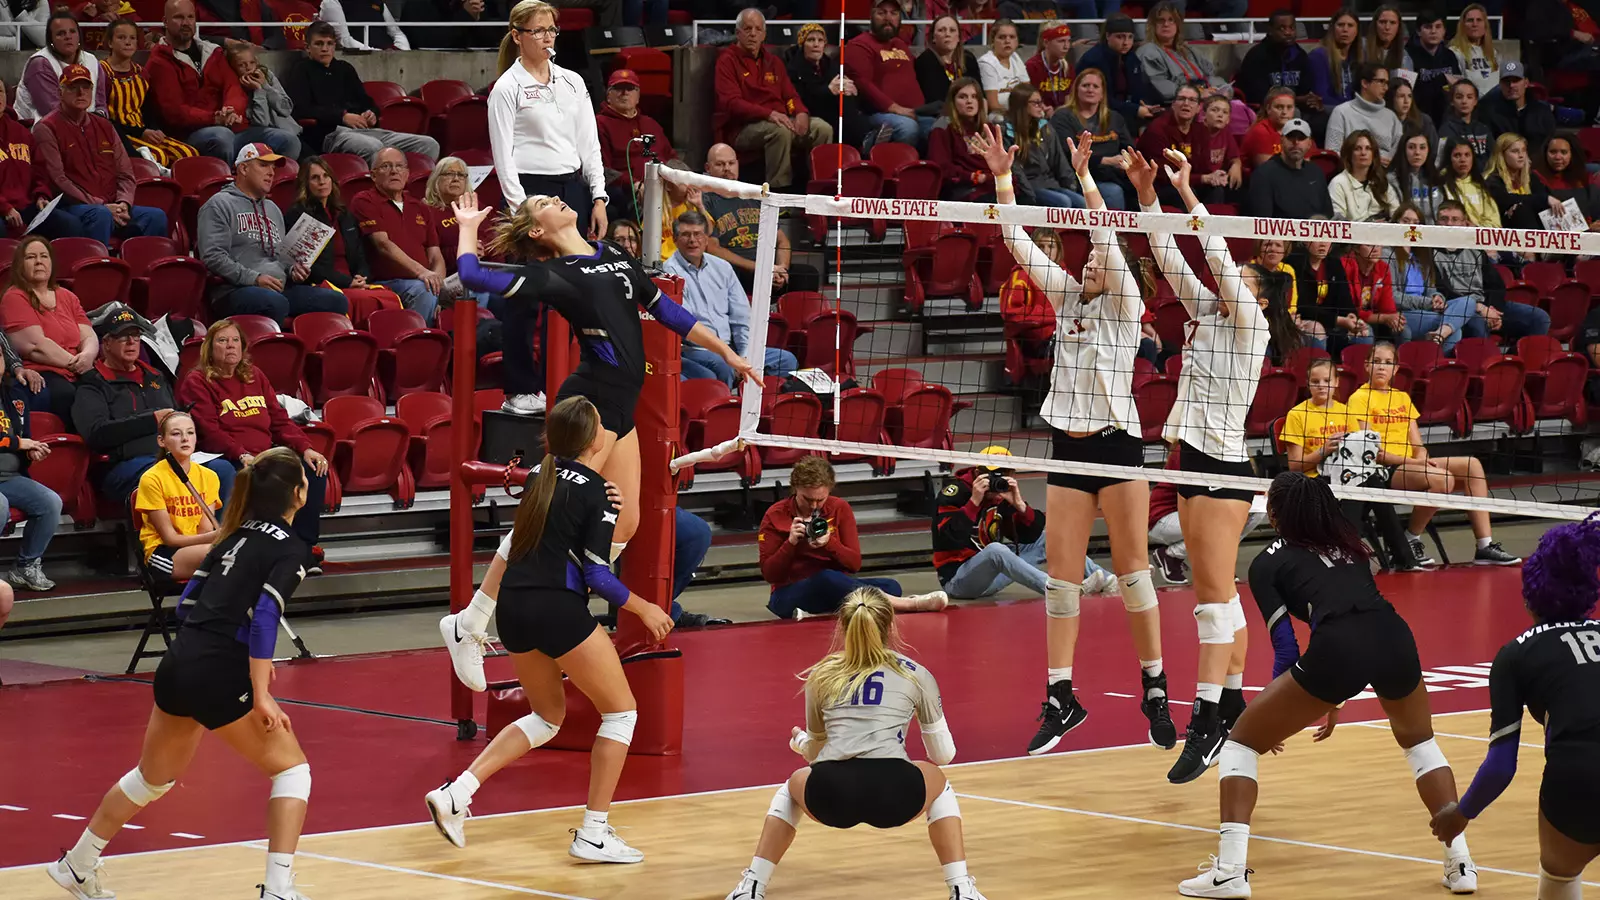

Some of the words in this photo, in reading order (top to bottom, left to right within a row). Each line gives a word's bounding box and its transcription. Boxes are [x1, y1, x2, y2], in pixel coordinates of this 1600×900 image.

[851, 199, 889, 214] IOWA
[892, 200, 938, 216] STATE
[1046, 208, 1086, 225] IOWA
[1089, 211, 1138, 228] STATE
[237, 212, 260, 234] IOWA
[1254, 218, 1296, 236] IOWA
[1300, 221, 1352, 239] STATE
[1475, 229, 1521, 246] IOWA
[1525, 231, 1581, 250] STATE
[615, 272, 633, 299] 3
[1187, 320, 1200, 345] 7
[237, 396, 267, 410] STATE
[240, 519, 290, 541] LDCATS
[221, 537, 247, 576] 4
[1560, 630, 1600, 664] 18
